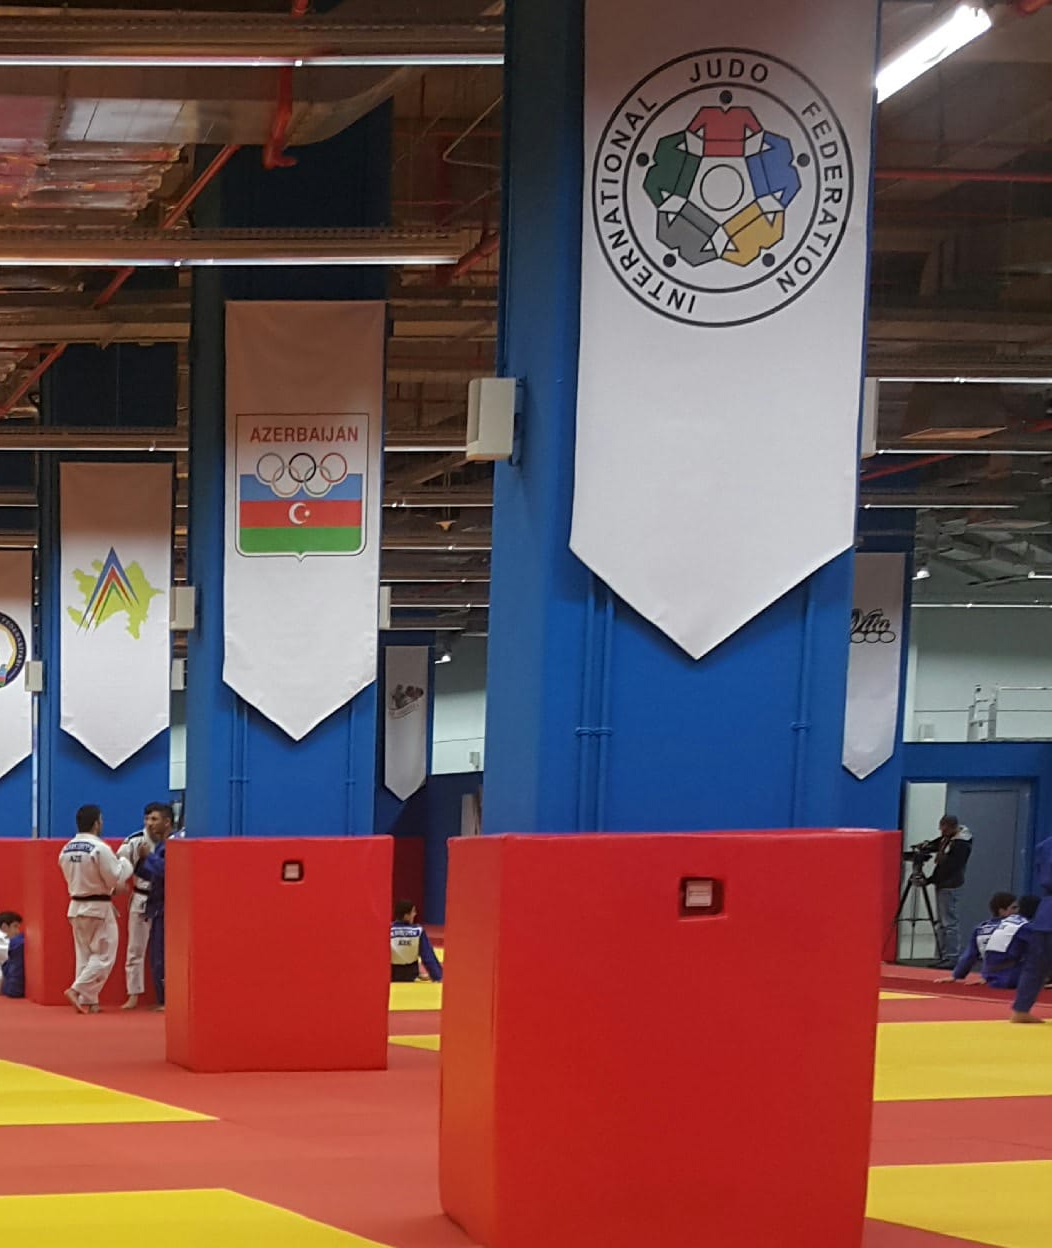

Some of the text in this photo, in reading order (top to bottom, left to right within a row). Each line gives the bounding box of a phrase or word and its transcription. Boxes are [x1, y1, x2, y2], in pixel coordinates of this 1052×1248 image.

[600, 58, 843, 314] INTERNATIONAL JUDO FEDERATION
[250, 426, 358, 443] AZERBAIJAN
